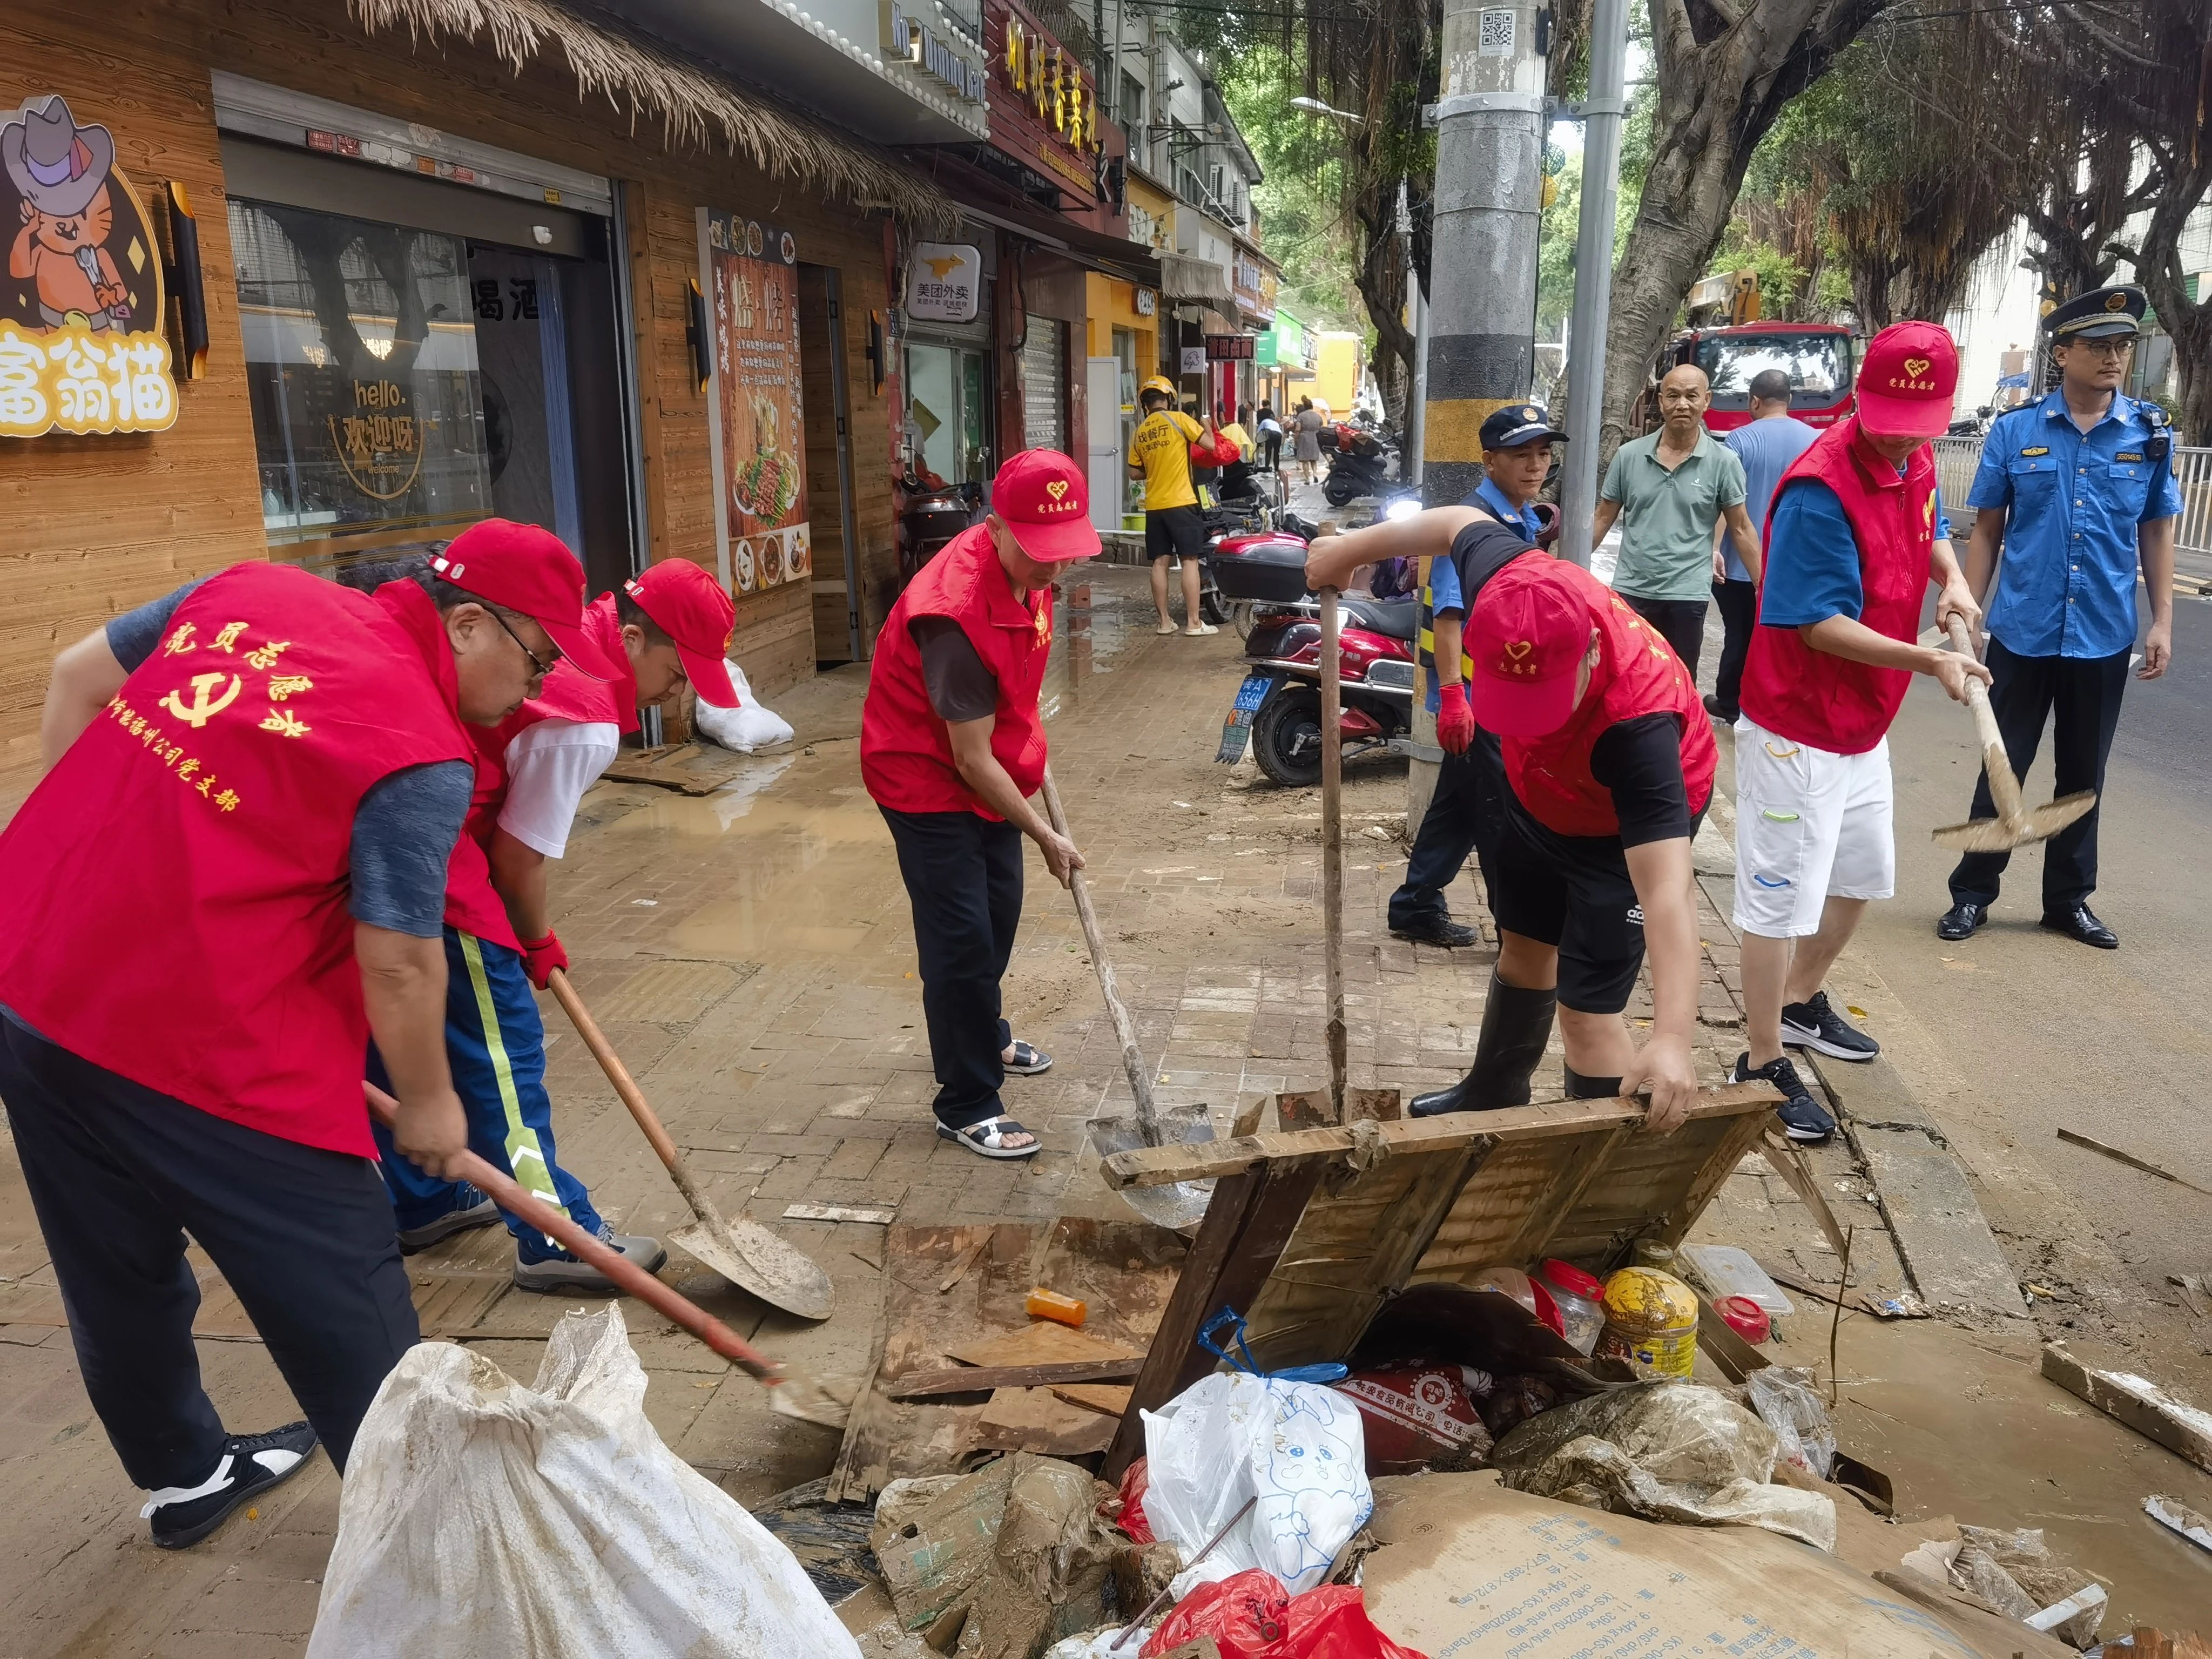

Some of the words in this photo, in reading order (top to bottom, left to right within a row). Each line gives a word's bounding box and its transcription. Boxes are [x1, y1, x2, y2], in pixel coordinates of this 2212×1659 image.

[918, 283, 968, 300] 美团外卖
[0, 332, 171, 424] 富翁猫
[1889, 377, 1936, 390] 党员志愿者
[354, 379, 406, 408] hello.
[342, 415, 415, 455] 欢迎呀
[367, 464, 400, 474] welcome
[1037, 500, 1077, 514] 党员志愿者
[1498, 661, 1537, 675] 志愿者
[163, 621, 314, 738] 党员志愿者
